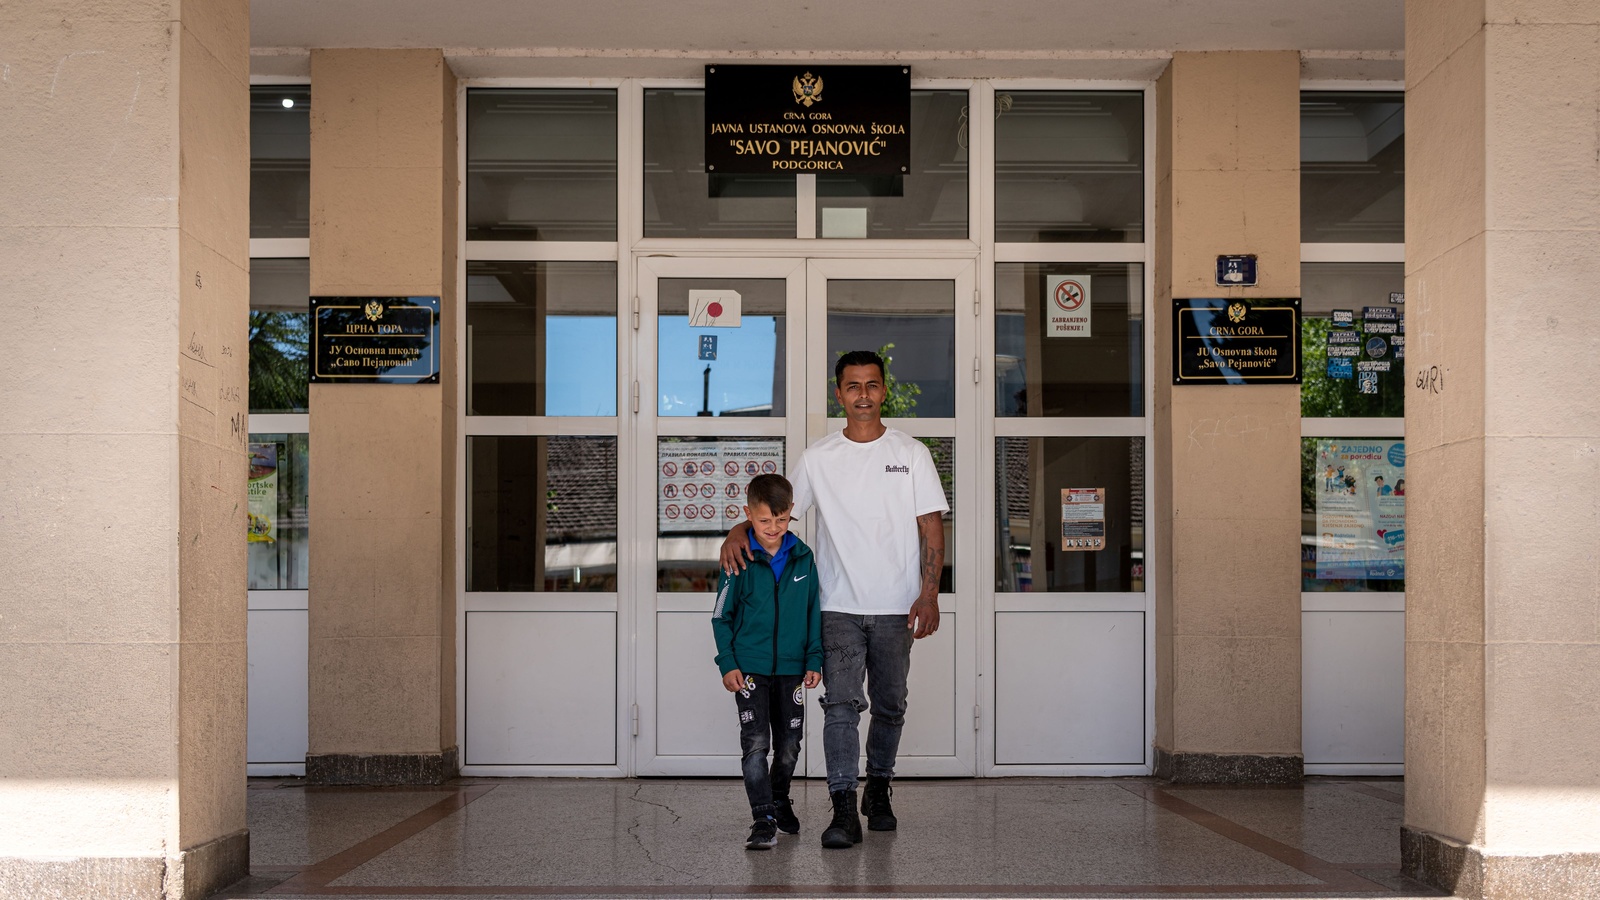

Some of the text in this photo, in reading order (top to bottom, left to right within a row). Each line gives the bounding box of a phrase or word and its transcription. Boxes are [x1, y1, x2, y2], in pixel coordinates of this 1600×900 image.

[783, 112, 832, 120] CRNA GORA
[711, 121, 905, 135] JAVNA USTANOVA OSNOVNA ŠKOLA
[730, 137, 886, 158] "SAVO PEJANOVIĆ"
[772, 160, 844, 170] PODGORICA
[346, 324, 403, 334] ЦРНА ГОРА
[1209, 326, 1265, 335] CRNA GORA
[328, 345, 420, 355] ЈУ Основна школа
[1196, 346, 1278, 356] JU Osnovna škola
